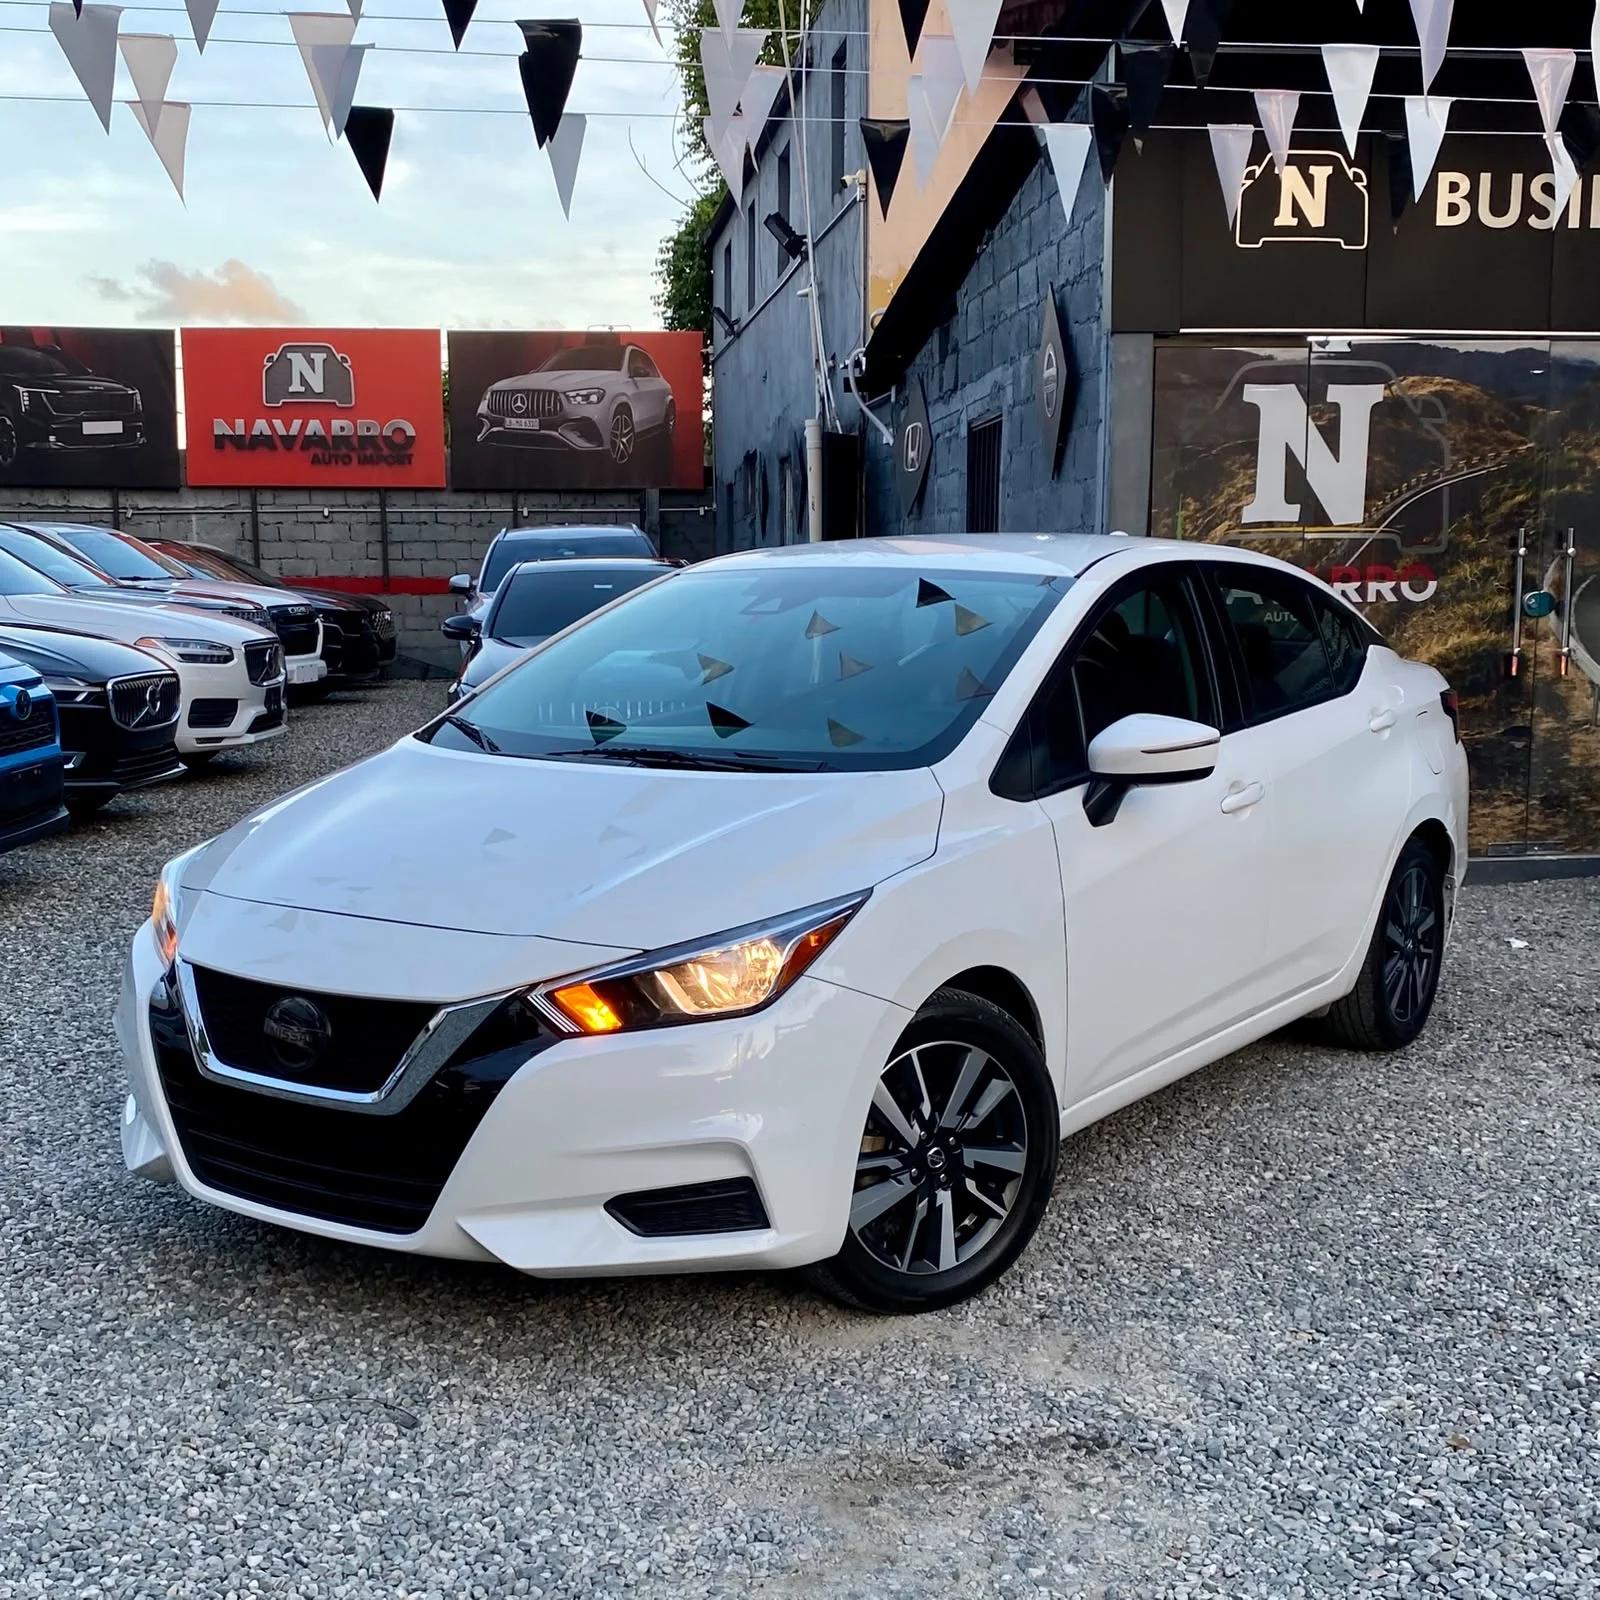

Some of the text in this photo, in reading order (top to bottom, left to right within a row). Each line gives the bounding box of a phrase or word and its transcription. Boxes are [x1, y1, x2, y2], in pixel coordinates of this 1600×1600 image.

[1273, 165, 1334, 228] N
[1435, 171, 1600, 230] BUSI
[286, 352, 327, 394] N
[213, 418, 416, 451] NAVARRO
[1242, 383, 1385, 526] N
[311, 452, 414, 466] AUTO IMPORT
[1305, 564, 1438, 603] RRO
